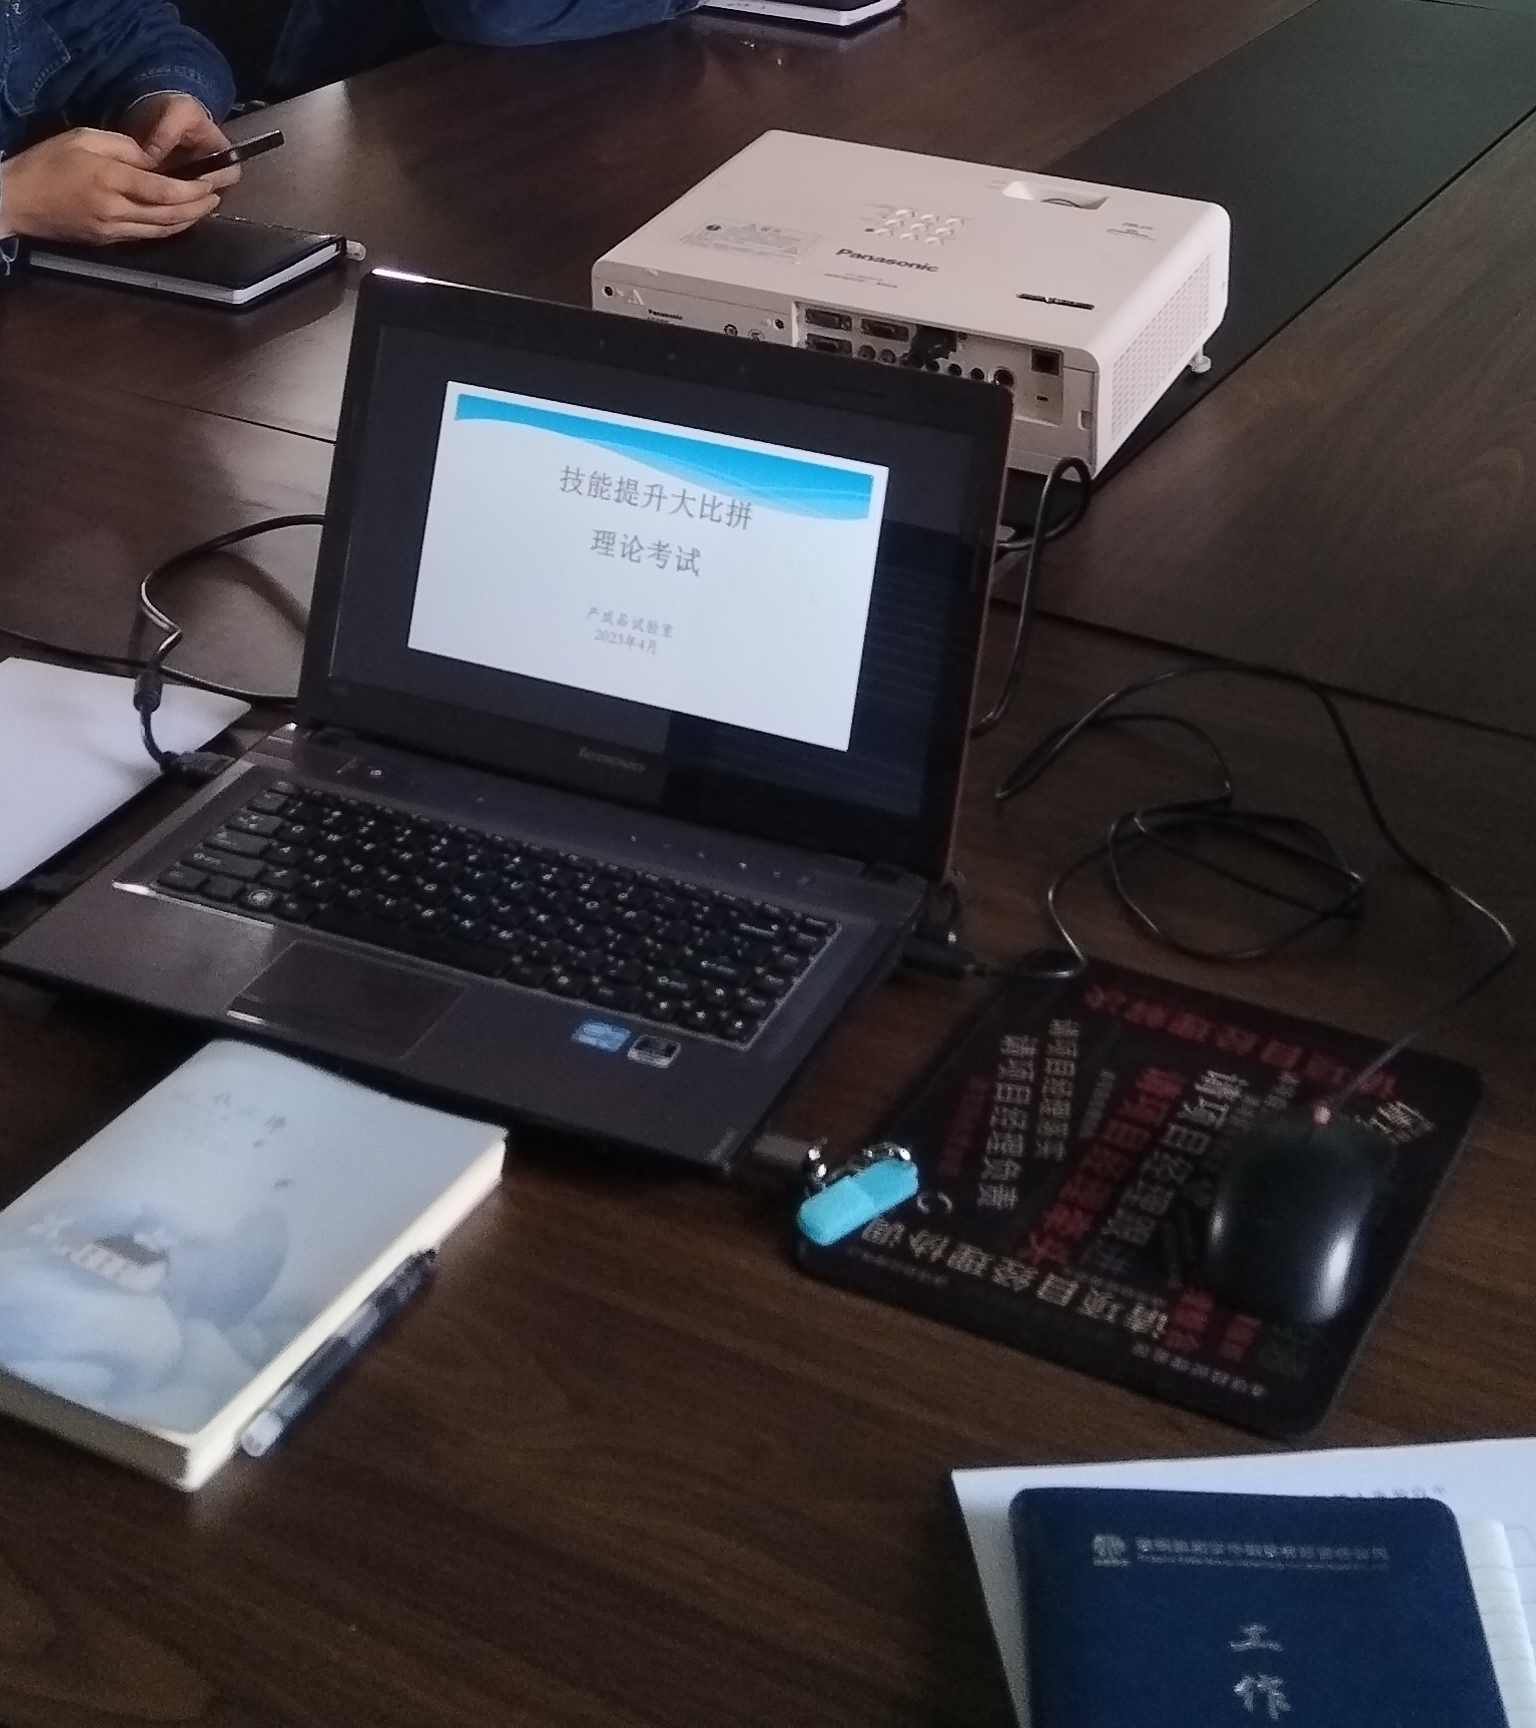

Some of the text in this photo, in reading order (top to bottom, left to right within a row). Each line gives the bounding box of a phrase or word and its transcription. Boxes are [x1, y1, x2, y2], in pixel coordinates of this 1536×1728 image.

[835, 247, 939, 273] Panasonic
[558, 464, 755, 532] 技能提升大比拼
[590, 527, 702, 579] 理论考试
[585, 605, 677, 641] 产成品试验室
[593, 628, 659, 657] 2023年4月
[977, 1033, 1039, 1211] 请项目经理负责
